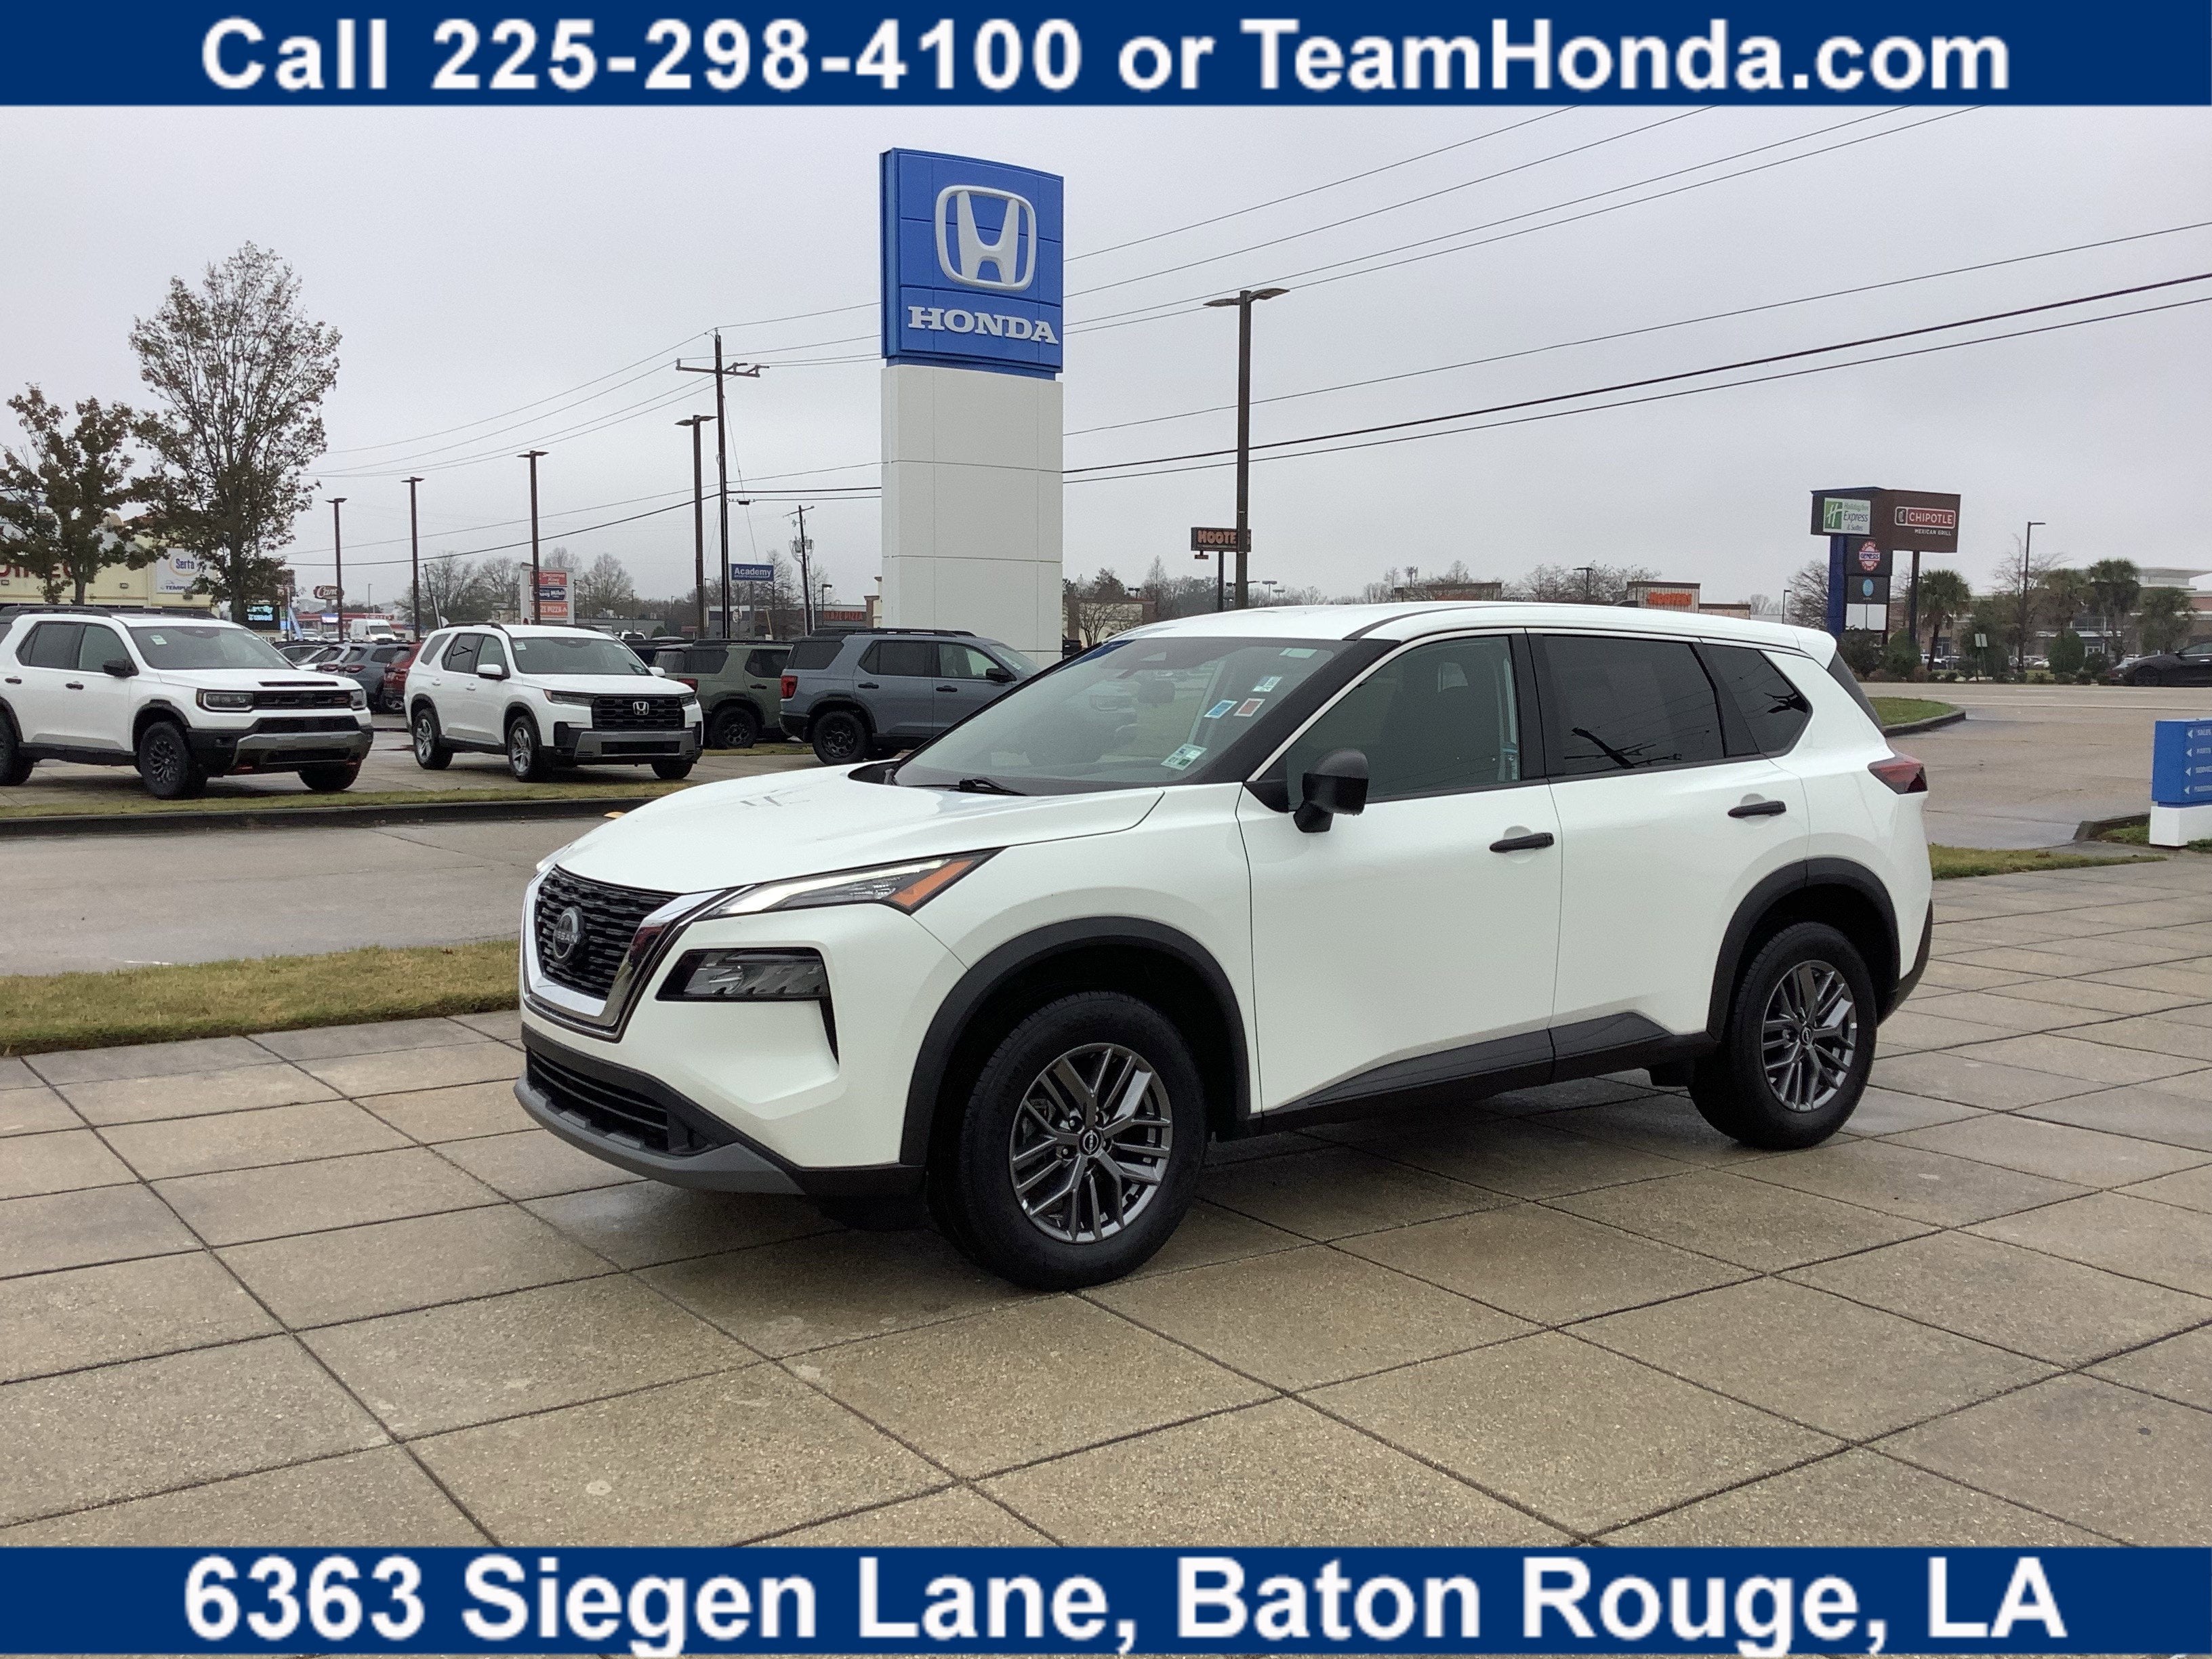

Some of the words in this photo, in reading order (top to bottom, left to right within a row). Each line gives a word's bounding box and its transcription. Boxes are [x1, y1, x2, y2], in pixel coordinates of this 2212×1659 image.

[908, 306, 1059, 344] HONDA
[1843, 510, 1868, 523] Express
[1908, 512, 1953, 525] CHIPOTLE
[176, 558, 195, 569] Serta
[734, 567, 772, 578] Academy
